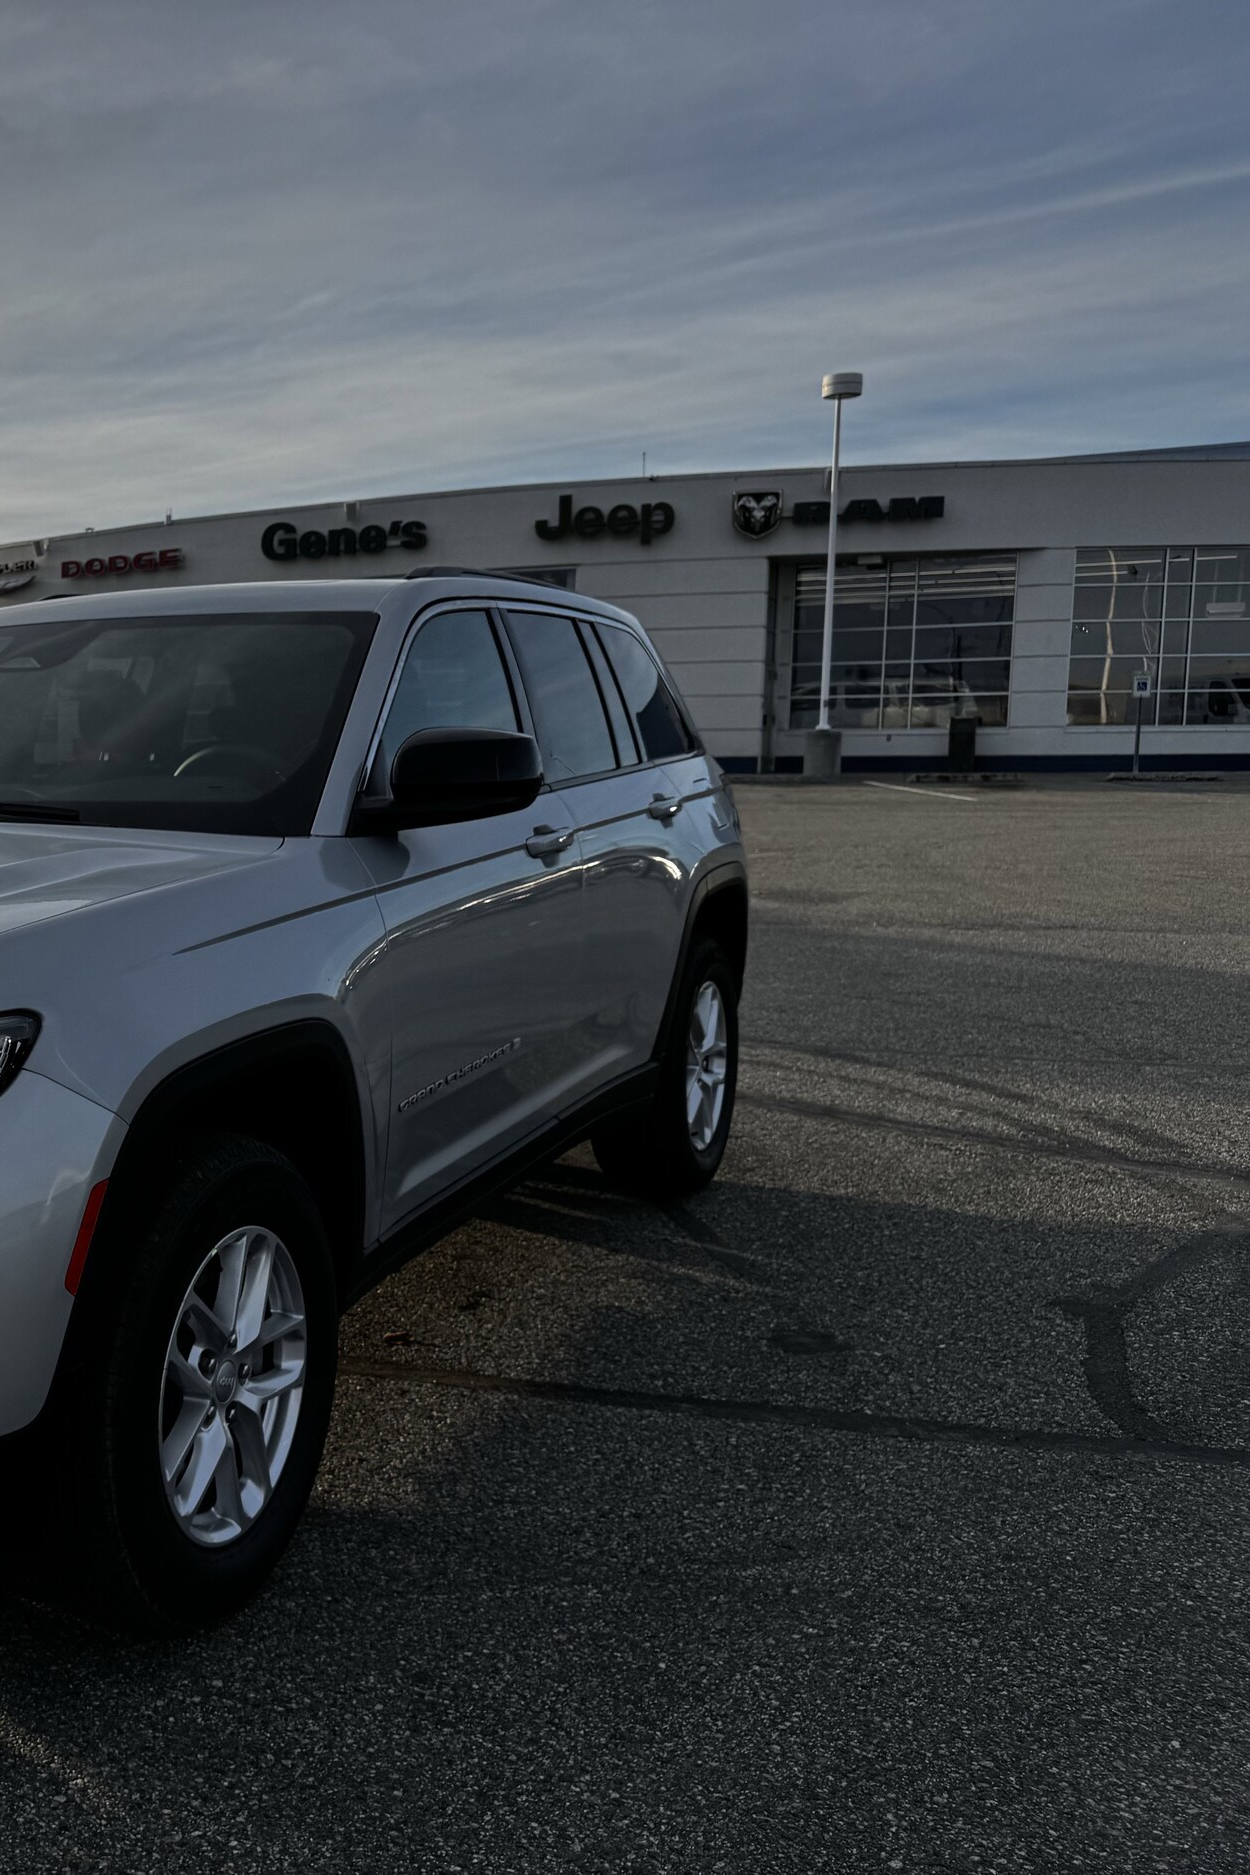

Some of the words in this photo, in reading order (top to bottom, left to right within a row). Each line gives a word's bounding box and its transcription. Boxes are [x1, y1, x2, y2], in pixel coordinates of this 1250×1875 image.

[535, 494, 674, 545] Jeep
[793, 496, 945, 525] RAM
[261, 520, 427, 561] Gene's
[61, 549, 182, 579] DODGE
